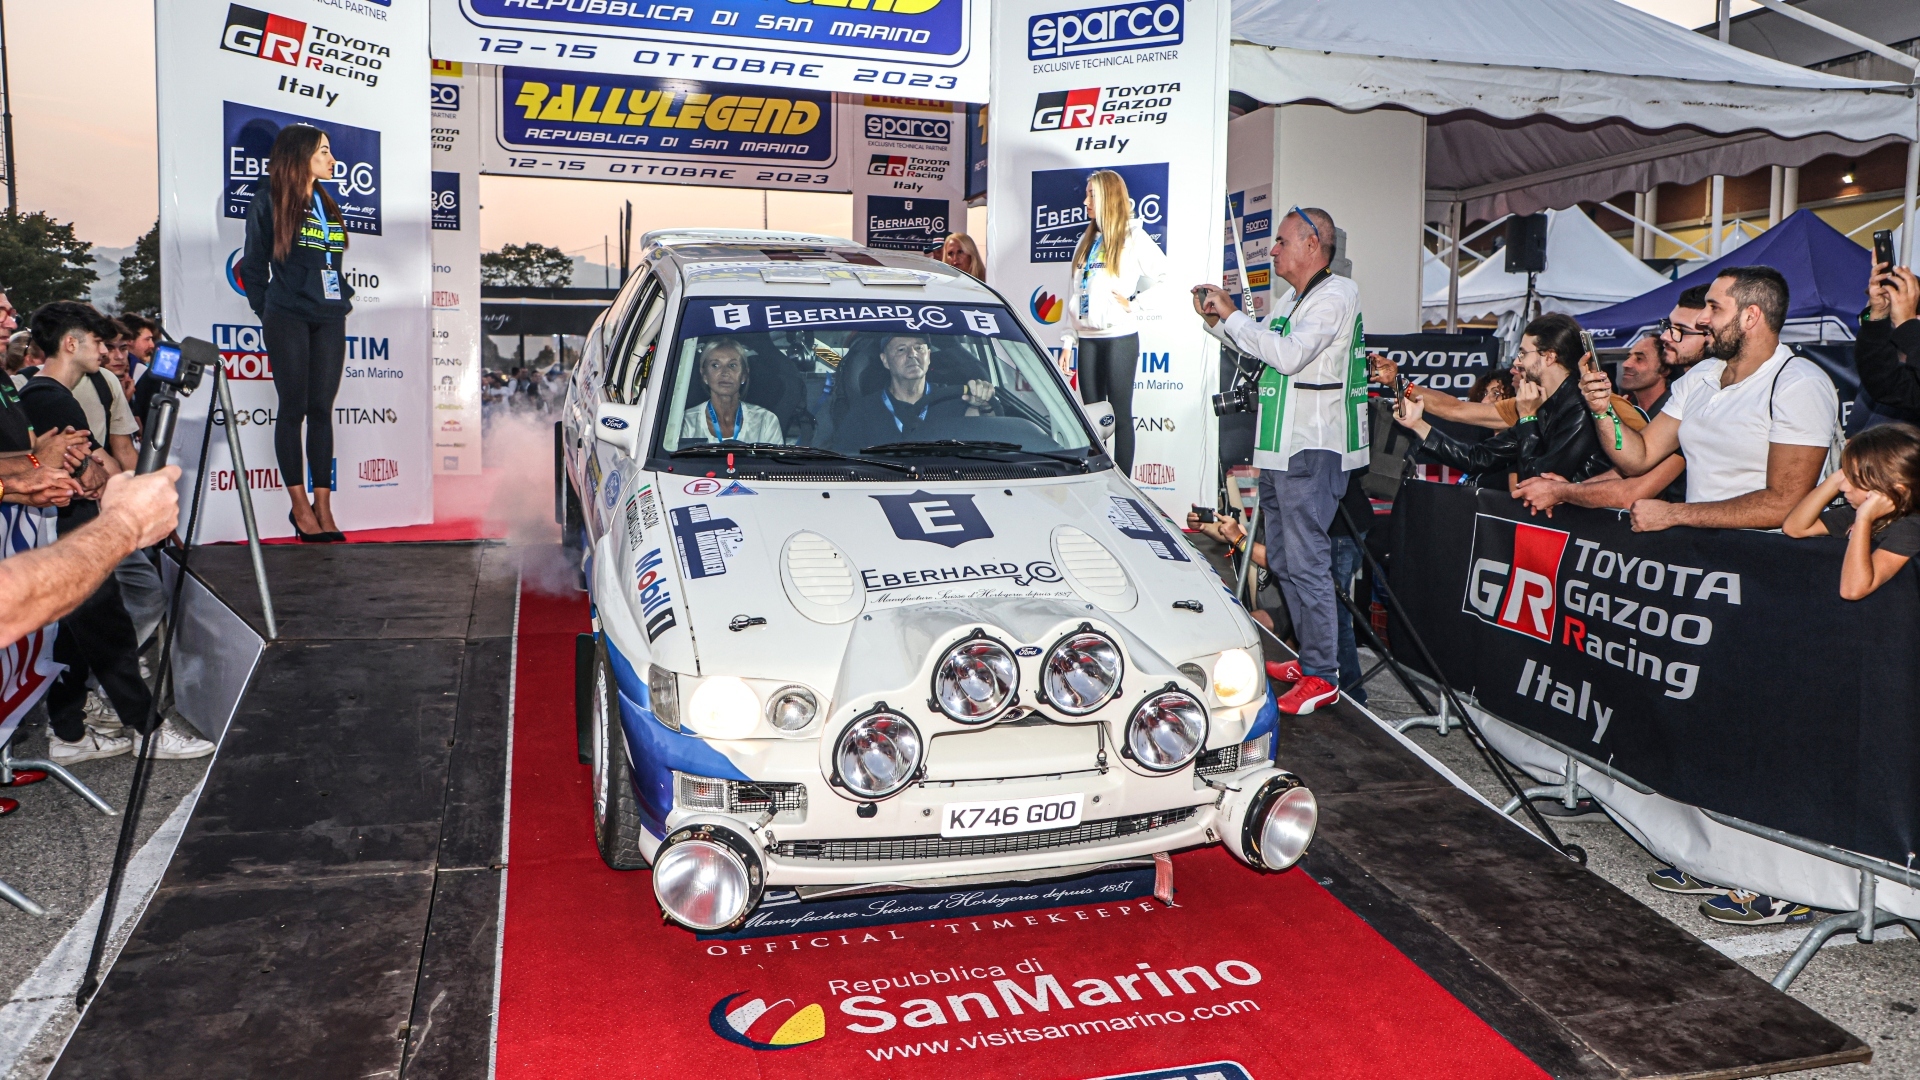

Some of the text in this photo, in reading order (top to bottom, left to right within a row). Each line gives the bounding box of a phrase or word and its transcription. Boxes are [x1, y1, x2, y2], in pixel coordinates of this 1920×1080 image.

[346, 1, 387, 21] PARTNER
[711, 10, 739, 26] DI
[756, 15, 814, 33] SAN
[829, 21, 931, 44] MARINO
[1032, 3, 1180, 55] sparco
[223, 24, 301, 65] GR
[312, 26, 391, 57] TOYOTA
[308, 42, 382, 70] GAZOO
[478, 37, 958, 90] 12-15 OTTOBRE 2023
[1033, 50, 1178, 74] EXCLUSIVE TECHNICAL PARTNER
[305, 56, 378, 87] Racing
[278, 75, 339, 107] Italy
[1105, 82, 1181, 98] TOYOTA
[515, 81, 821, 136] RALLYLEGEND
[1102, 97, 1172, 112] GAZOO
[867, 117, 949, 139] sparco
[1033, 104, 1095, 130] GR
[1099, 111, 1168, 125] Racing
[524, 127, 810, 155] REPUBBLICA DI SAN MARINO
[868, 141, 948, 152] EXCLUSIVE TECHNICAL PARTNER
[1075, 135, 1130, 153] Italy
[508, 157, 830, 185] 12-15 OTTOBRE 2023
[868, 162, 904, 176] GR
[908, 164, 946, 173] GAZOO
[910, 157, 950, 167] TOYOTA
[893, 181, 924, 193] Italy
[907, 171, 944, 181] Racing
[870, 216, 931, 230] EBERHARD
[1035, 251, 1071, 259] OFFICI
[1250, 276, 1268, 285] IRELLI
[724, 309, 739, 324] E
[765, 305, 912, 325] EBERHARD
[975, 314, 991, 329] E
[345, 336, 389, 360] TIM
[1365, 347, 1489, 368] TOYOTA
[345, 366, 404, 379] San Marino
[1142, 352, 1170, 373] IM
[1133, 379, 1184, 390] an Marino
[606, 418, 624, 429] Ford
[359, 459, 398, 481] LAURETANA
[1135, 463, 1175, 484] LAURETANA
[908, 500, 964, 534] E
[695, 530, 726, 575] KANKKUNEN
[635, 547, 671, 618] Mobil
[861, 562, 1019, 589] EBERHARD
[1574, 538, 1741, 605] TOYOTA
[870, 593, 933, 605] Manufacture
[935, 590, 965, 600] Suisse
[1470, 557, 1553, 636] GR
[1563, 580, 1712, 646] GAZOO
[1562, 615, 1700, 700] Racing
[1516, 658, 1613, 744] Italy
[950, 806, 1019, 830] K746
[744, 880, 1134, 929] Manufacture Suisse d'Horlogerie depuis 1887
[706, 929, 905, 956] OFFICIAL
[828, 957, 1045, 996] Repubblica di
[839, 959, 1263, 1035] SanMarino
[866, 996, 1262, 1062] www.visitsanmarino.com
